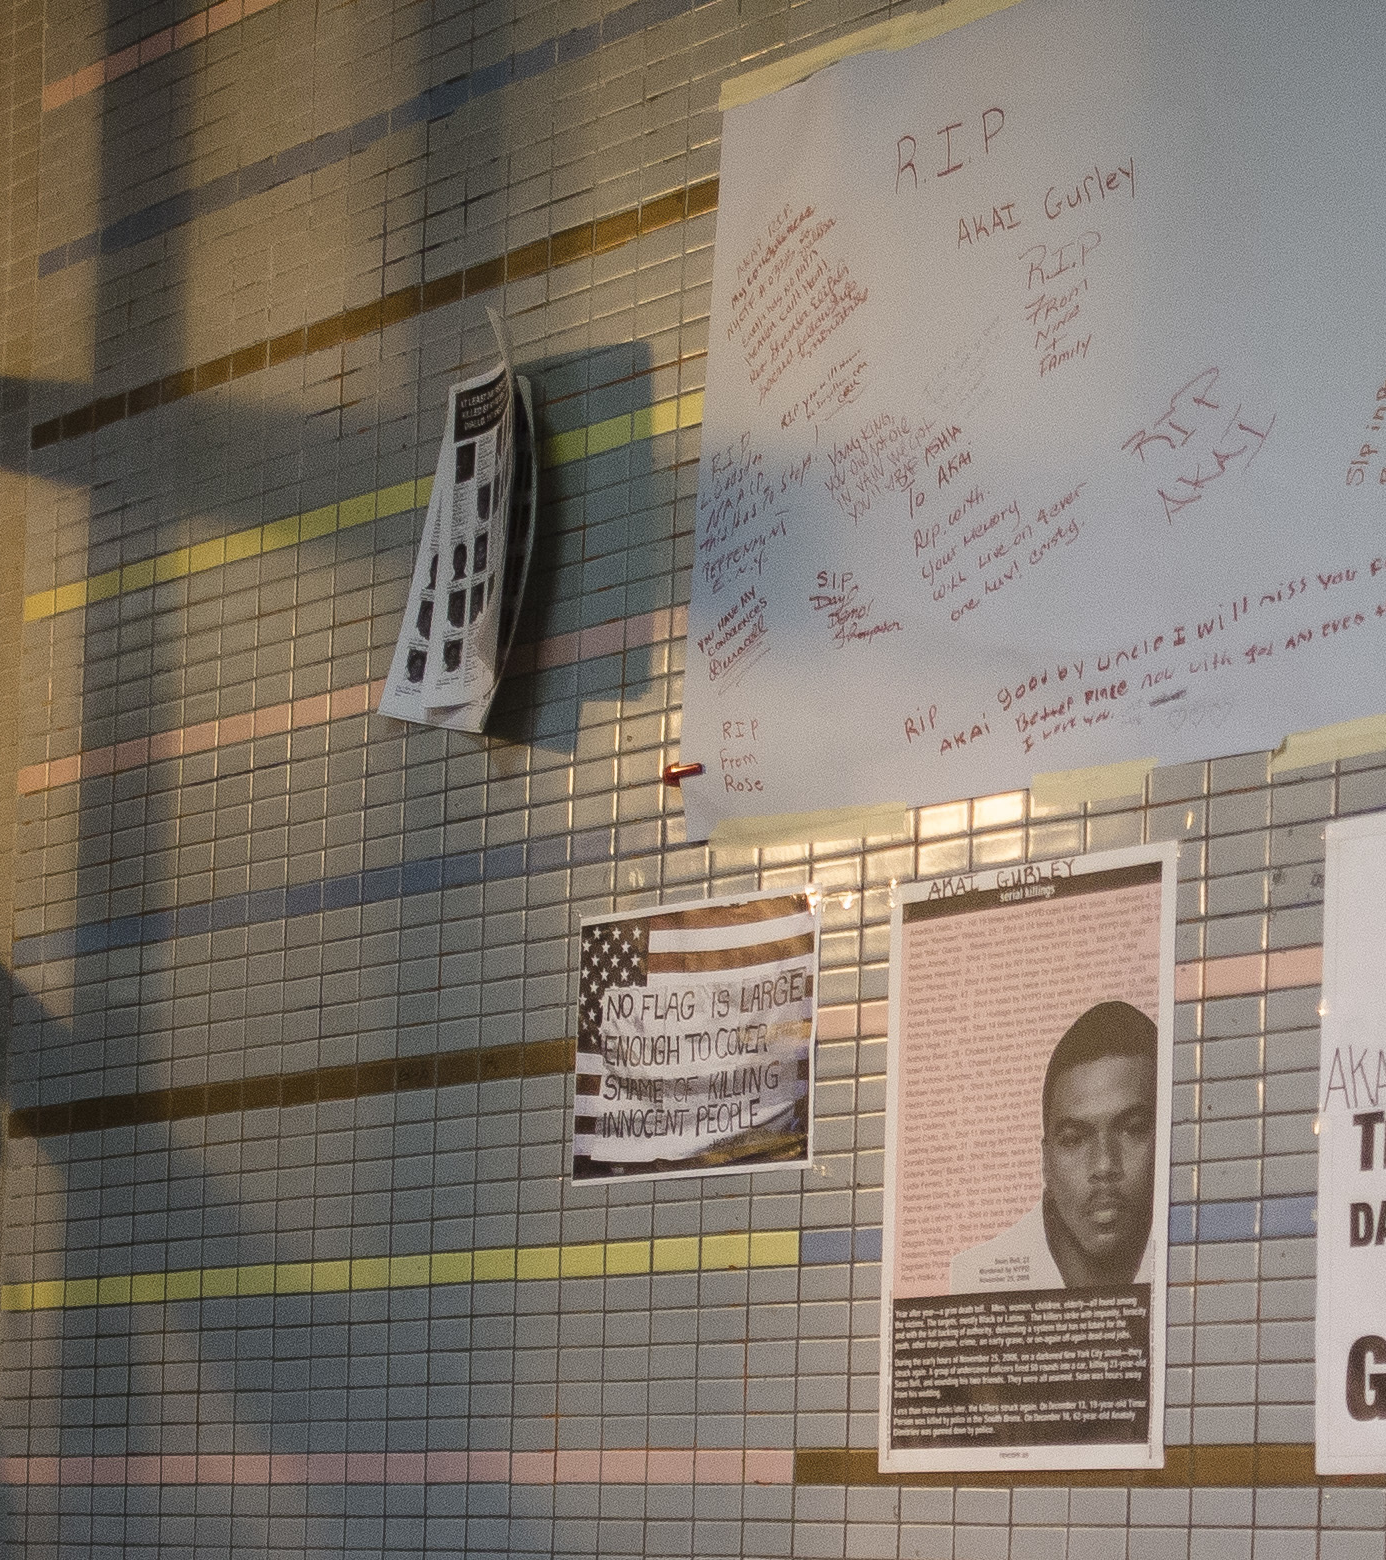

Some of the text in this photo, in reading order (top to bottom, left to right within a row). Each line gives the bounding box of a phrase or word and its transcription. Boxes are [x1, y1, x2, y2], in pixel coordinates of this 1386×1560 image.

[956, 156, 1137, 249] AKAI Gurley
[927, 871, 979, 901] AKAI
[1028, 883, 1056, 900] killings
[605, 968, 804, 1021] NO FLAG IS LARGE
[603, 1023, 768, 1066] ENOUGH TO COVER
[603, 1061, 780, 1102] SHAME OF KILLING
[602, 1098, 760, 1138] INNOCENT PEOPLE
